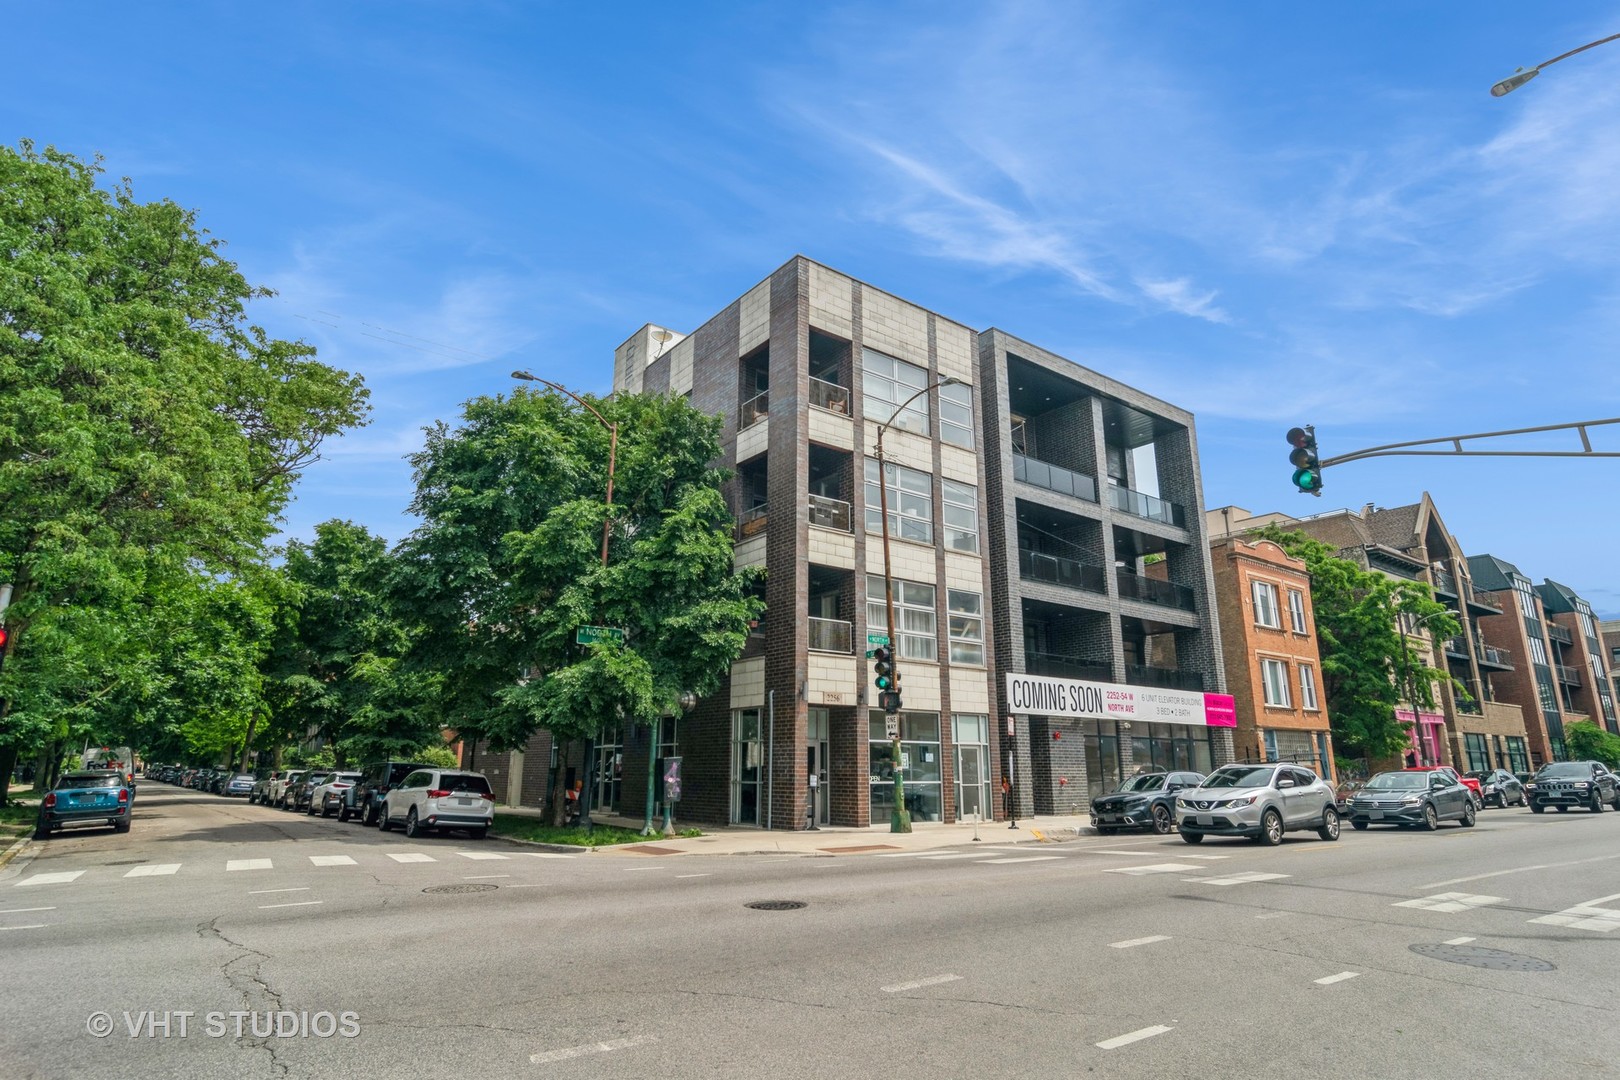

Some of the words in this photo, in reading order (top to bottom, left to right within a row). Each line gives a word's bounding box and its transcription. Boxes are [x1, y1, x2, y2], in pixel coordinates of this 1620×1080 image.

[826, 693, 841, 703] 2256
[1013, 680, 1066, 711] COMING
[1069, 685, 1103, 713] SOON
[1106, 691, 1128, 700] 2252-54
[1128, 693, 1134, 701] W
[1145, 695, 1157, 703] UNIT
[1158, 695, 1181, 705] ELEVATOR
[1181, 697, 1202, 706] BUILDING
[1107, 703, 1124, 712] NORTH
[1125, 705, 1134, 713] AVE
[1160, 707, 1170, 715] BED
[1174, 708, 1178, 716] 2
[1178, 708, 1191, 717] BATH
[87, 760, 124, 770] FedEx
